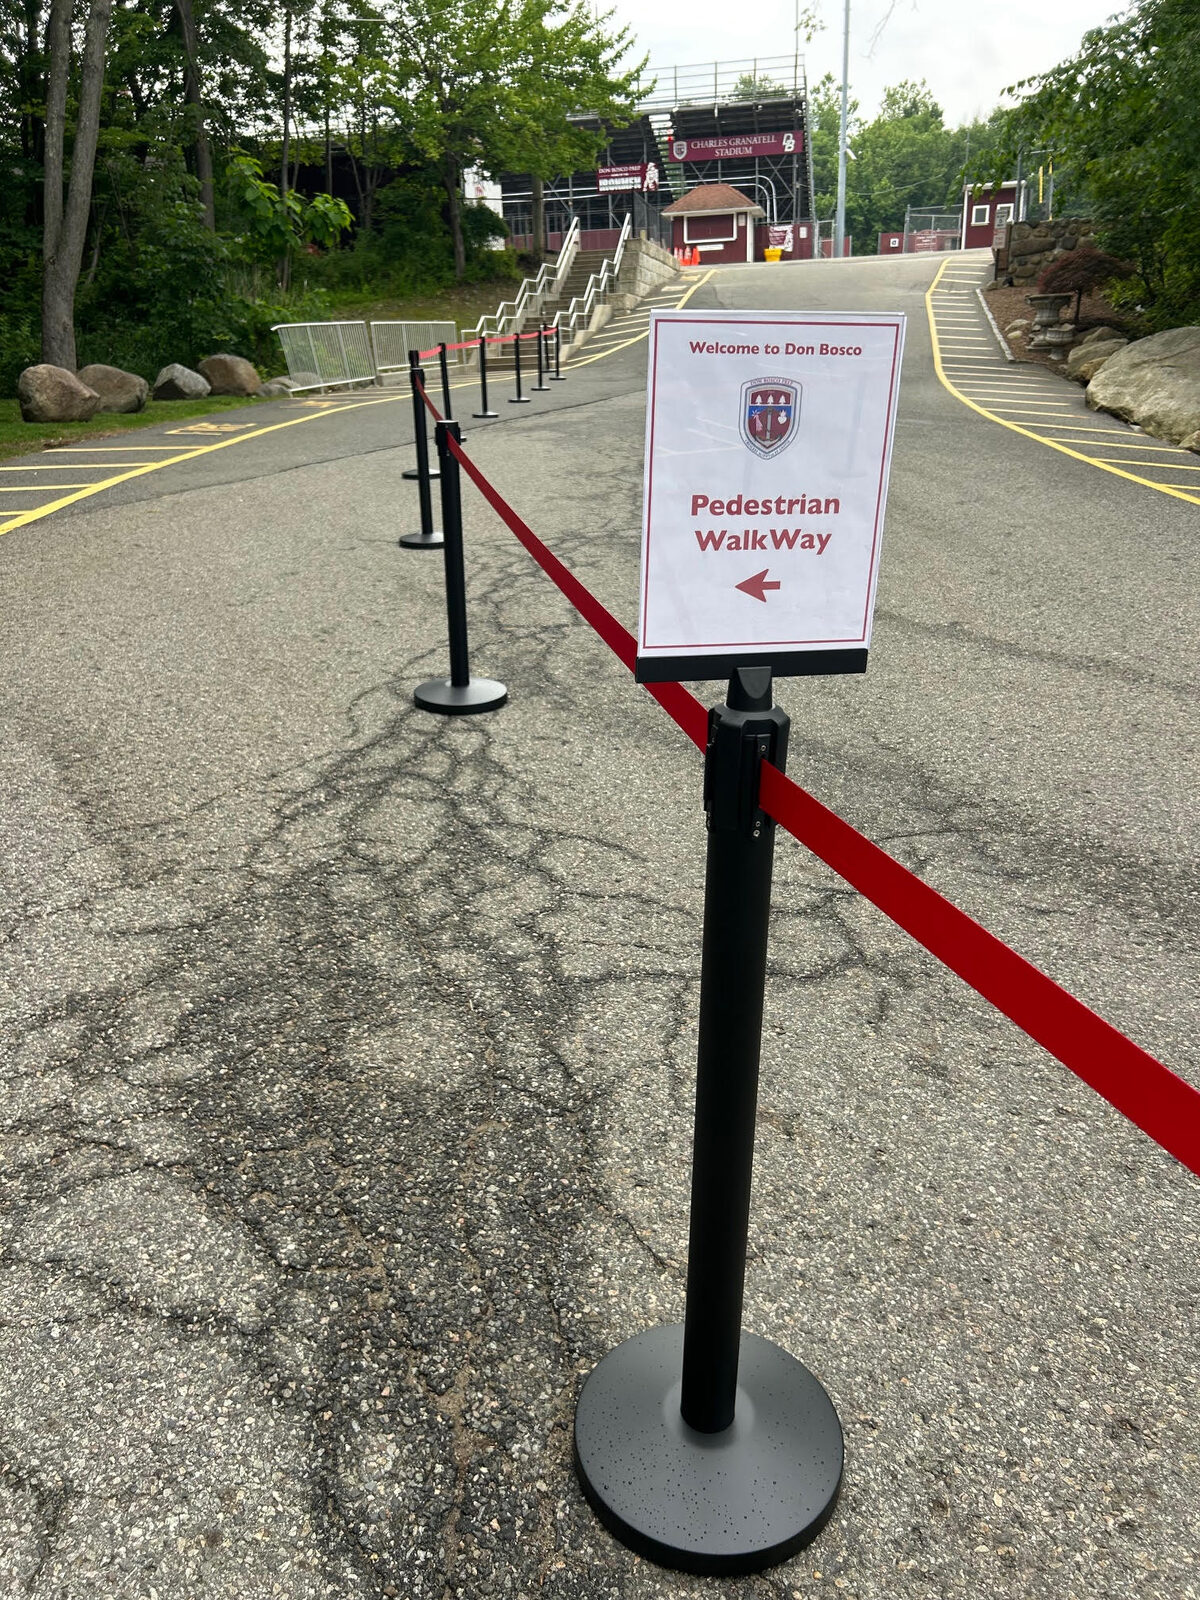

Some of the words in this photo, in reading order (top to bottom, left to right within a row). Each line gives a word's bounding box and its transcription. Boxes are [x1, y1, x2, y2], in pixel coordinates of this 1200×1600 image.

[691, 138, 728, 149] CHARLES
[729, 135, 777, 146] GRANATELL
[715, 147, 753, 157] STADIUM
[689, 341, 760, 355] Welcome
[764, 343, 780, 355] to
[785, 343, 814, 355] Don
[819, 343, 862, 356] Bosco
[691, 493, 840, 516] Pedestrian
[694, 528, 833, 555] WalkWay
